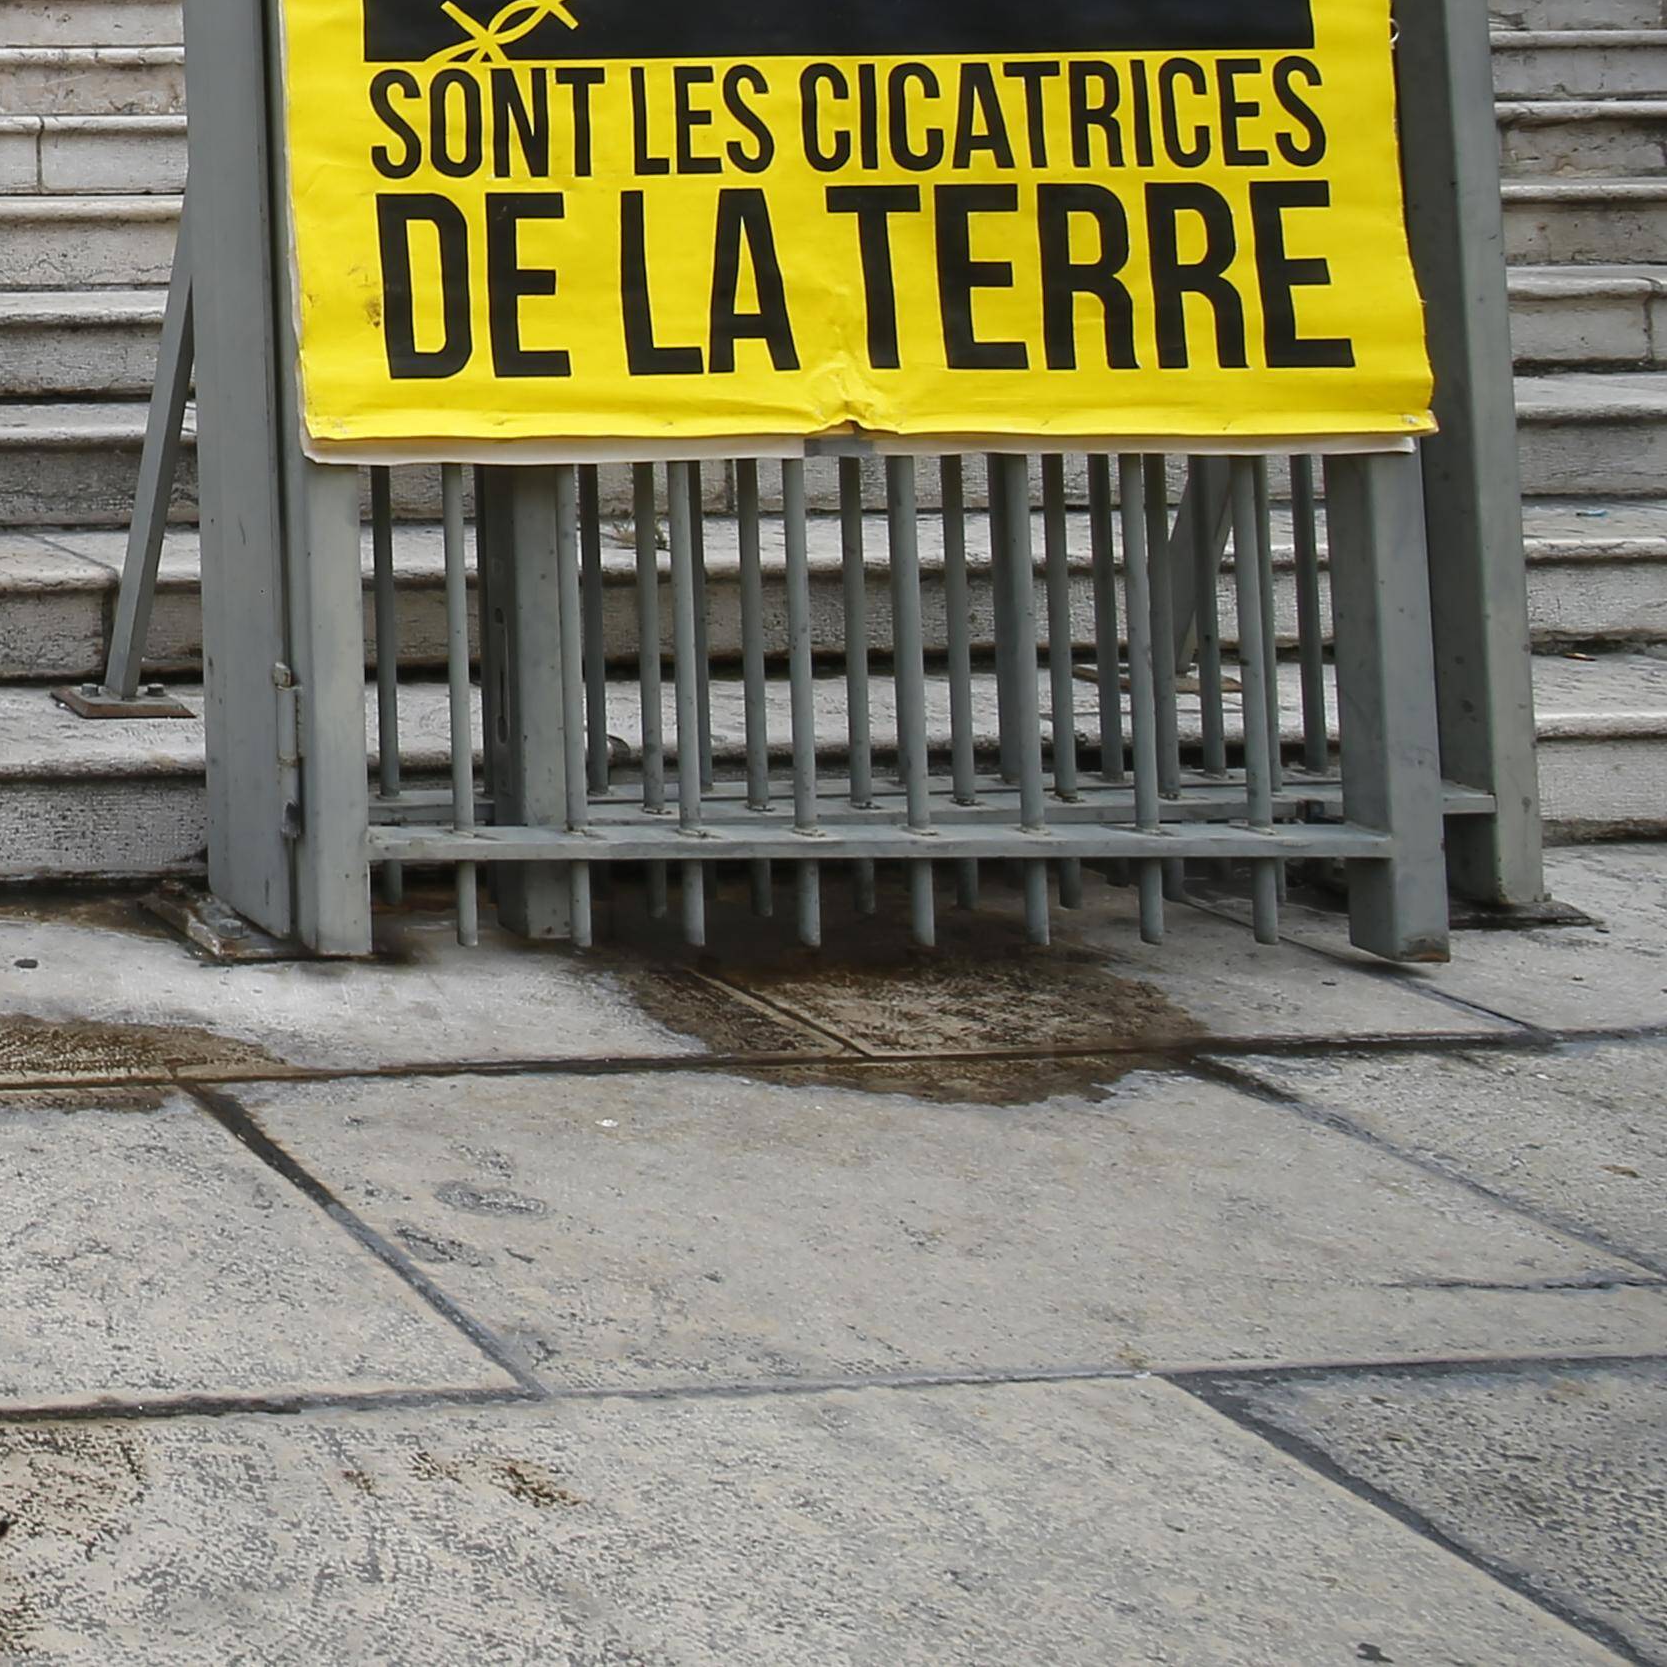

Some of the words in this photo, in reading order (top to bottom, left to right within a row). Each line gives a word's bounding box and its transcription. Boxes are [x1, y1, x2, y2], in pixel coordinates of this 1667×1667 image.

[369, 65, 607, 180] SONT
[629, 63, 776, 176] LES
[798, 56, 1328, 174] CICATRICES
[375, 191, 573, 381] DE
[619, 187, 802, 376] LA
[824, 179, 1357, 372] TERRE
